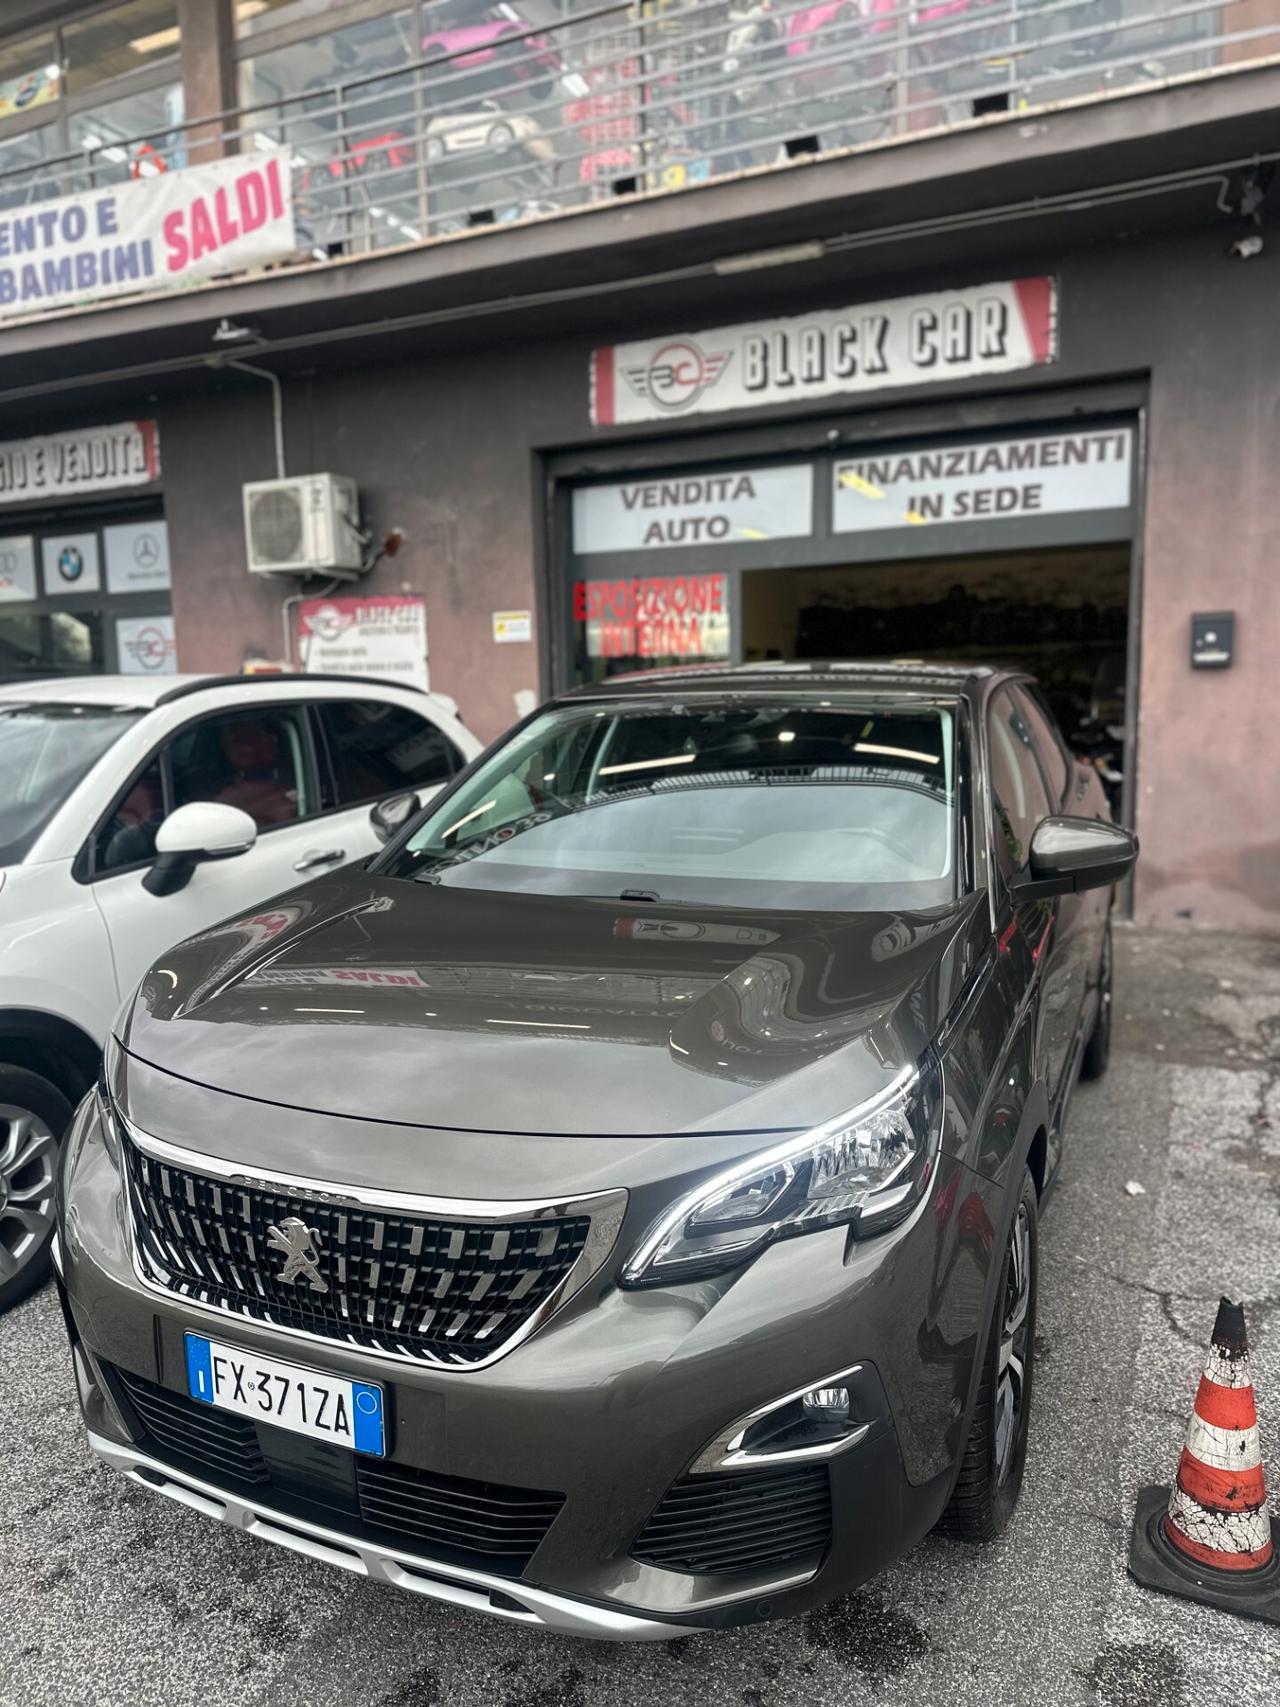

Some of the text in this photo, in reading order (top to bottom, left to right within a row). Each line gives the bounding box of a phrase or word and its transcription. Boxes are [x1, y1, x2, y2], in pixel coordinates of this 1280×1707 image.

[96, 197, 118, 237] E
[162, 158, 285, 273] SALDI
[0, 239, 155, 304] BAMBINI
[744, 298, 1007, 391] BLACK CAR
[53, 431, 147, 483] VENDITA
[837, 434, 1126, 490] FINANZIAMENTI
[620, 476, 756, 511] VENDITA
[907, 484, 1043, 519] IN SEDE
[643, 515, 731, 544] AUTO
[573, 573, 725, 622] ESPOSIZIONE
[600, 619, 704, 657] INTERNA
